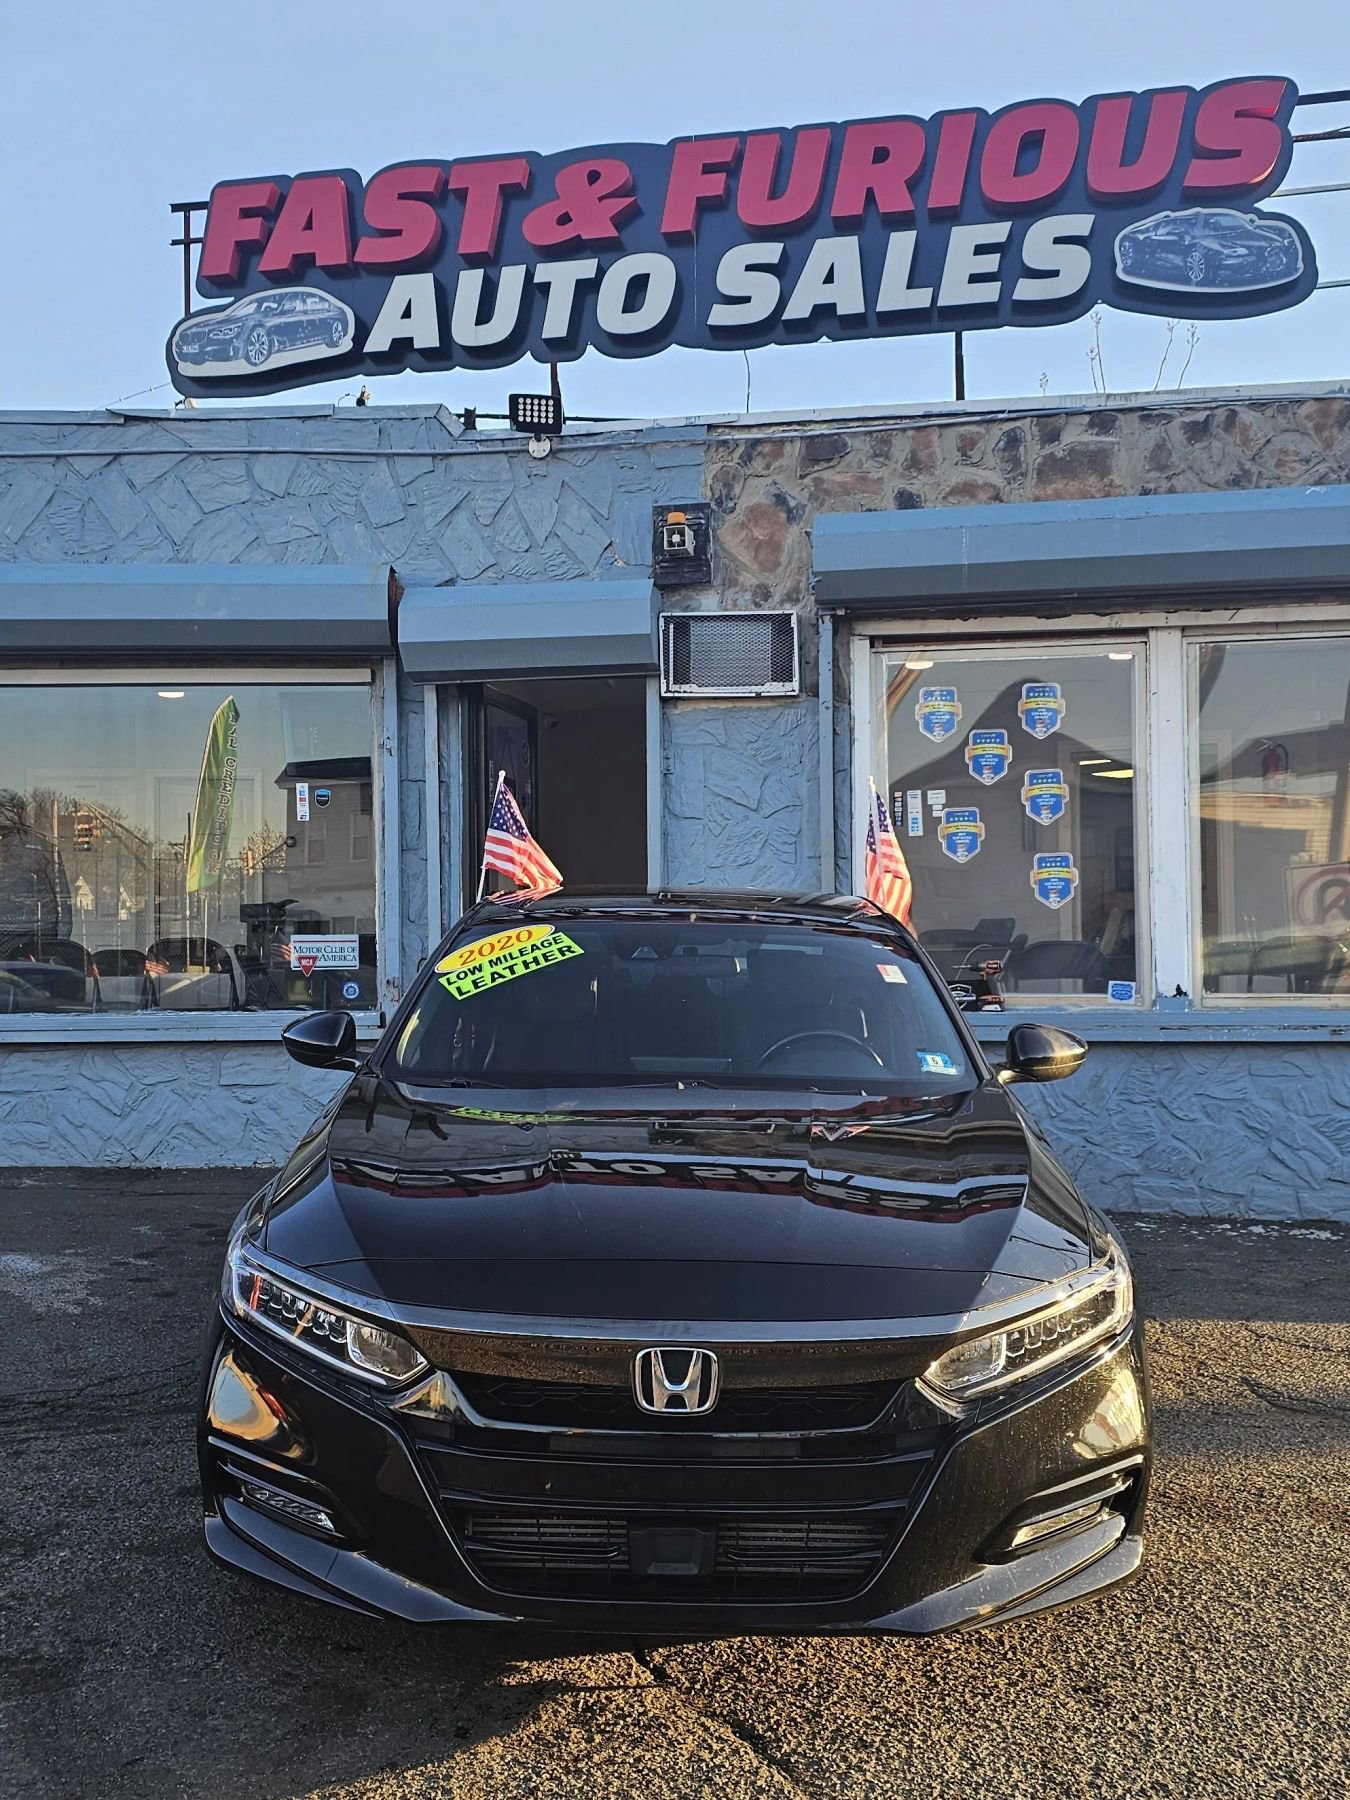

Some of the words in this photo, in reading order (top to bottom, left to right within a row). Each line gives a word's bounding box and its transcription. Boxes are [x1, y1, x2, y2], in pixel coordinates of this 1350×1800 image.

[200, 158, 530, 281] FAST
[522, 158, 641, 252] &
[660, 79, 1290, 243] FURIOUS
[363, 252, 677, 352] AUTO
[706, 213, 1096, 327] SALES
[293, 945, 323, 954] MOTOR
[323, 945, 345, 954] CLUB
[346, 946, 357, 954] OF
[319, 954, 357, 962] AMERICA
[445, 963, 485, 986] LOW
[488, 935, 564, 967] MILEAGE
[455, 944, 577, 998] LEATHER
[458, 929, 534, 967] 2020
